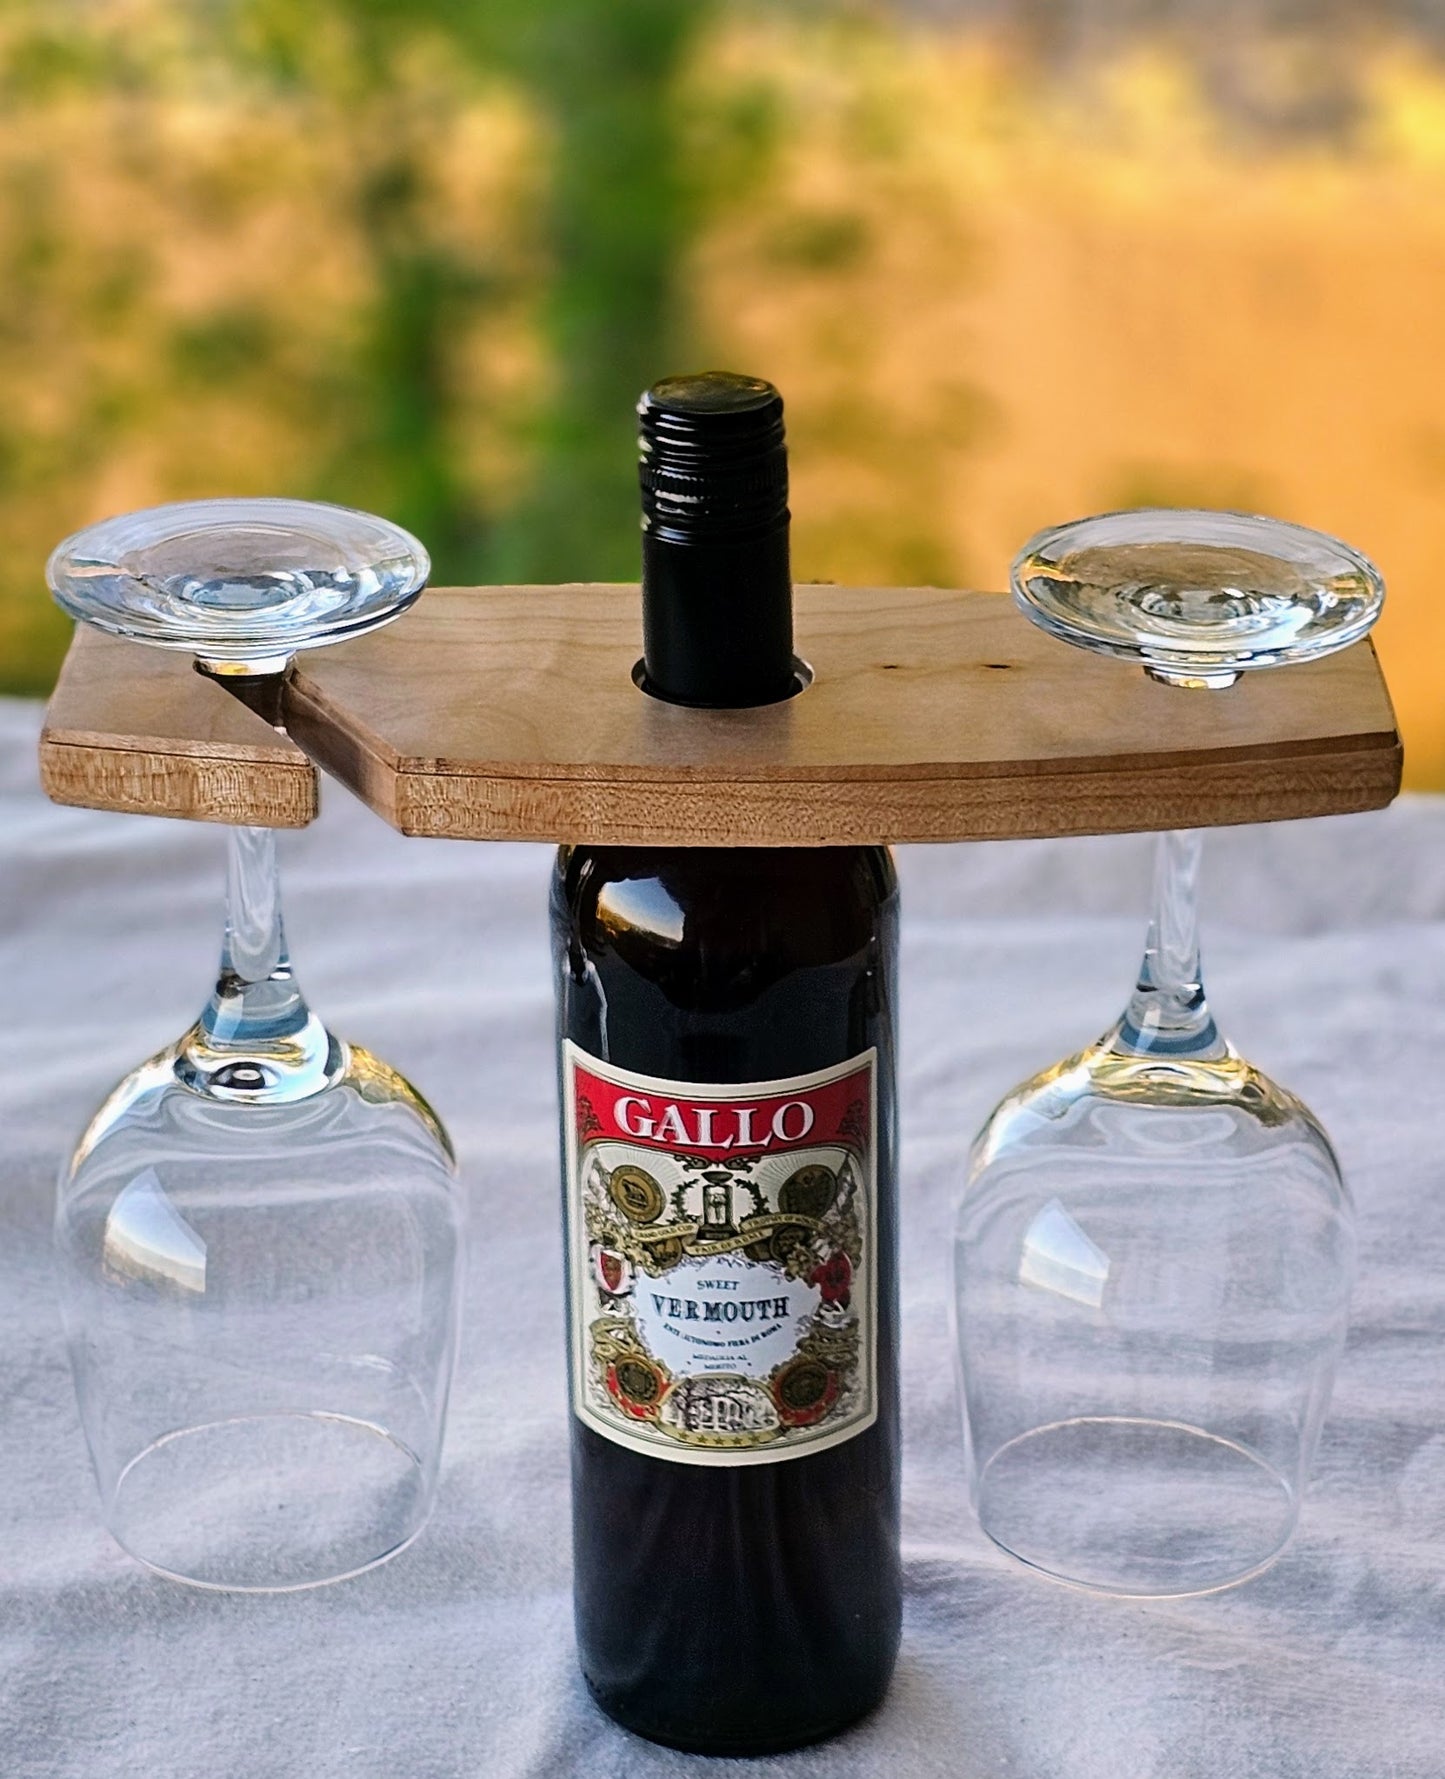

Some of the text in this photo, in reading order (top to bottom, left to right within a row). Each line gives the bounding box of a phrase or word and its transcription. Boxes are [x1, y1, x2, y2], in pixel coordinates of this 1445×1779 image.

[613, 1096, 815, 1149] GALLO
[695, 1244, 718, 1253] FAIR
[720, 1241, 732, 1250] OF
[696, 1279, 740, 1290] SWEET
[650, 1292, 790, 1323] VERMOUTH
